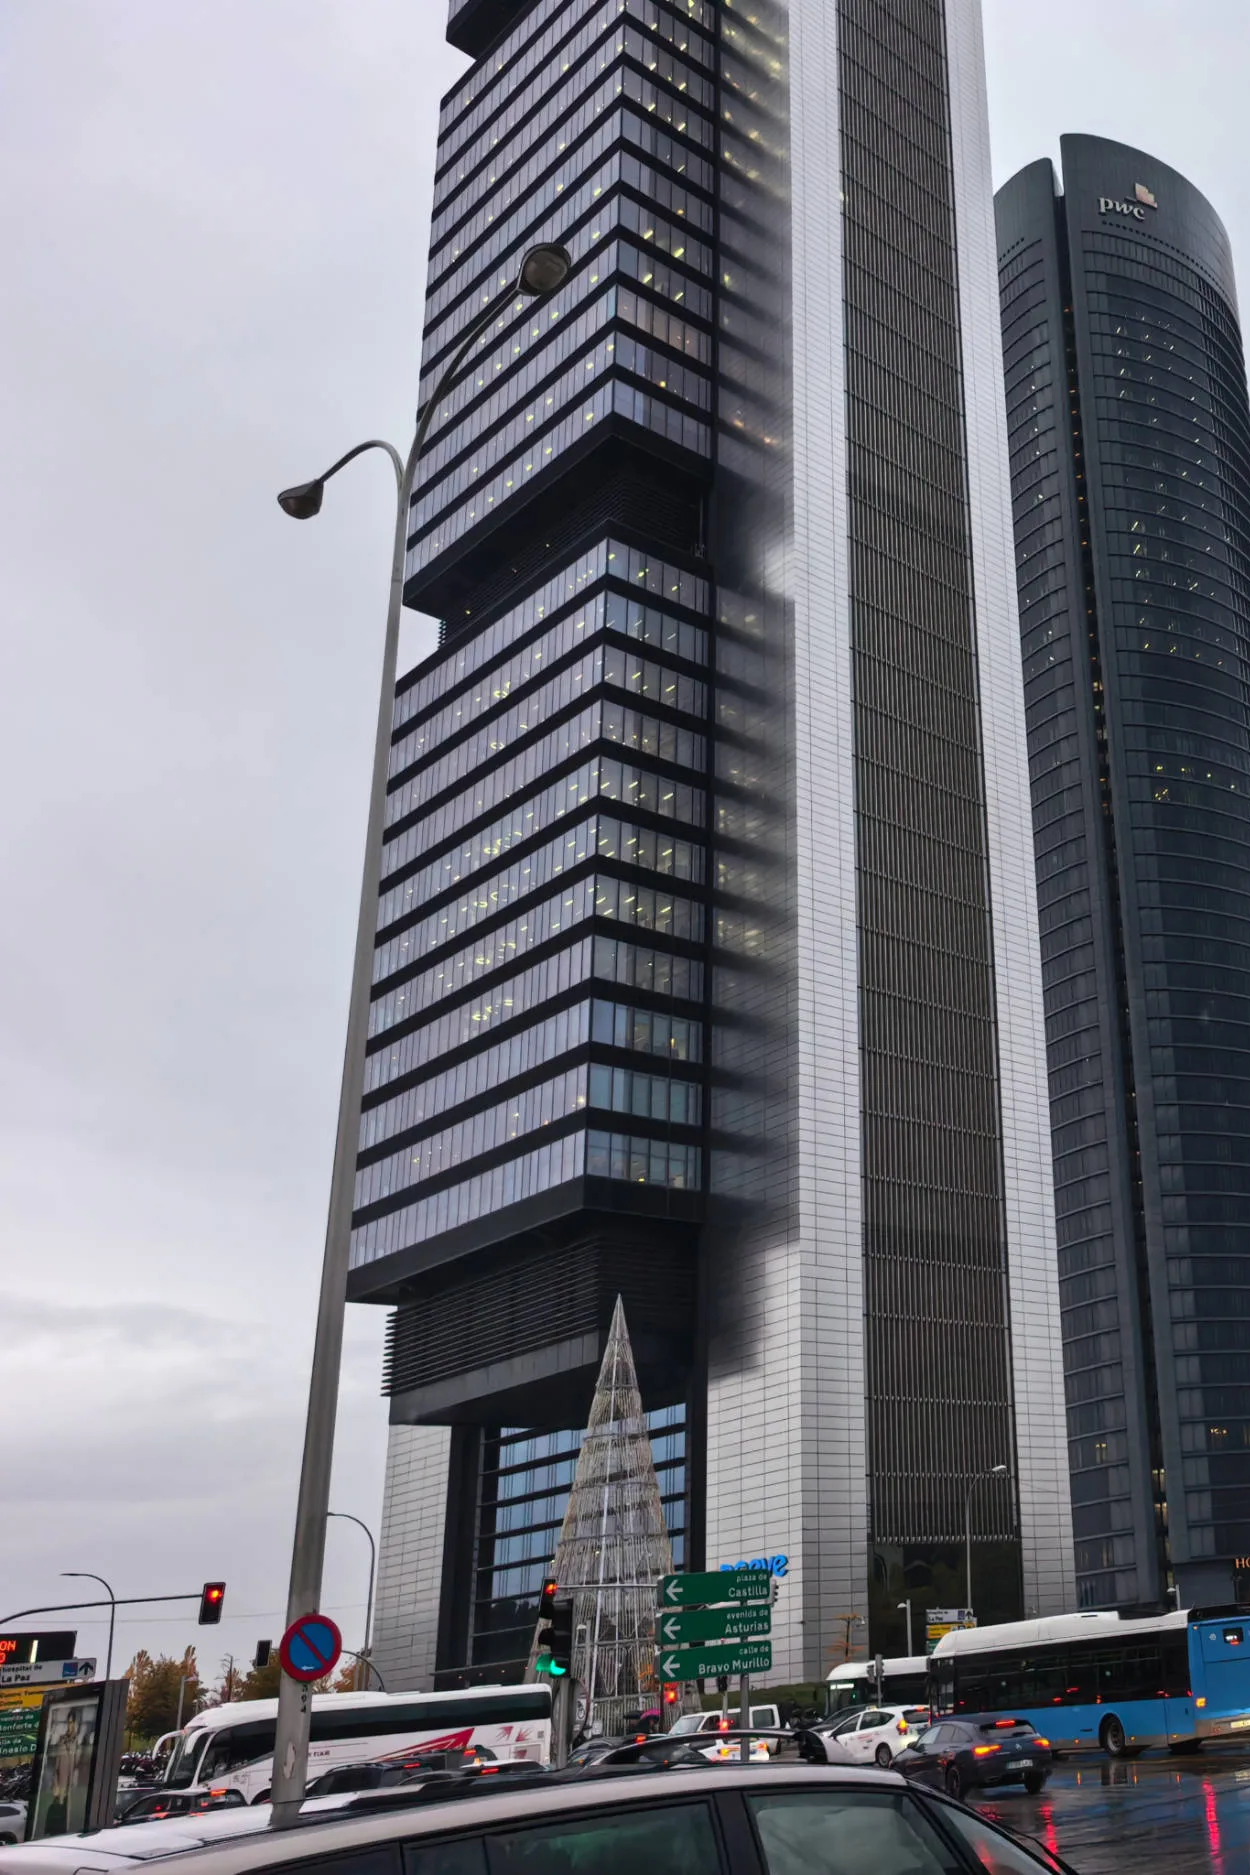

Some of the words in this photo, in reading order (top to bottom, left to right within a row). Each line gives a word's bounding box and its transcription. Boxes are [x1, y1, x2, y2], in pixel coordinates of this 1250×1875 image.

[1098, 197, 1146, 221] pwc
[728, 1585, 768, 1597] Castilla
[727, 1610, 757, 1620] avenida
[759, 1609, 768, 1617] de
[725, 1623, 769, 1634] Asturias
[739, 1647, 758, 1655] calle
[759, 1645, 769, 1653] de
[698, 1662, 730, 1674] Bravo
[732, 1658, 770, 1671] Murillo
